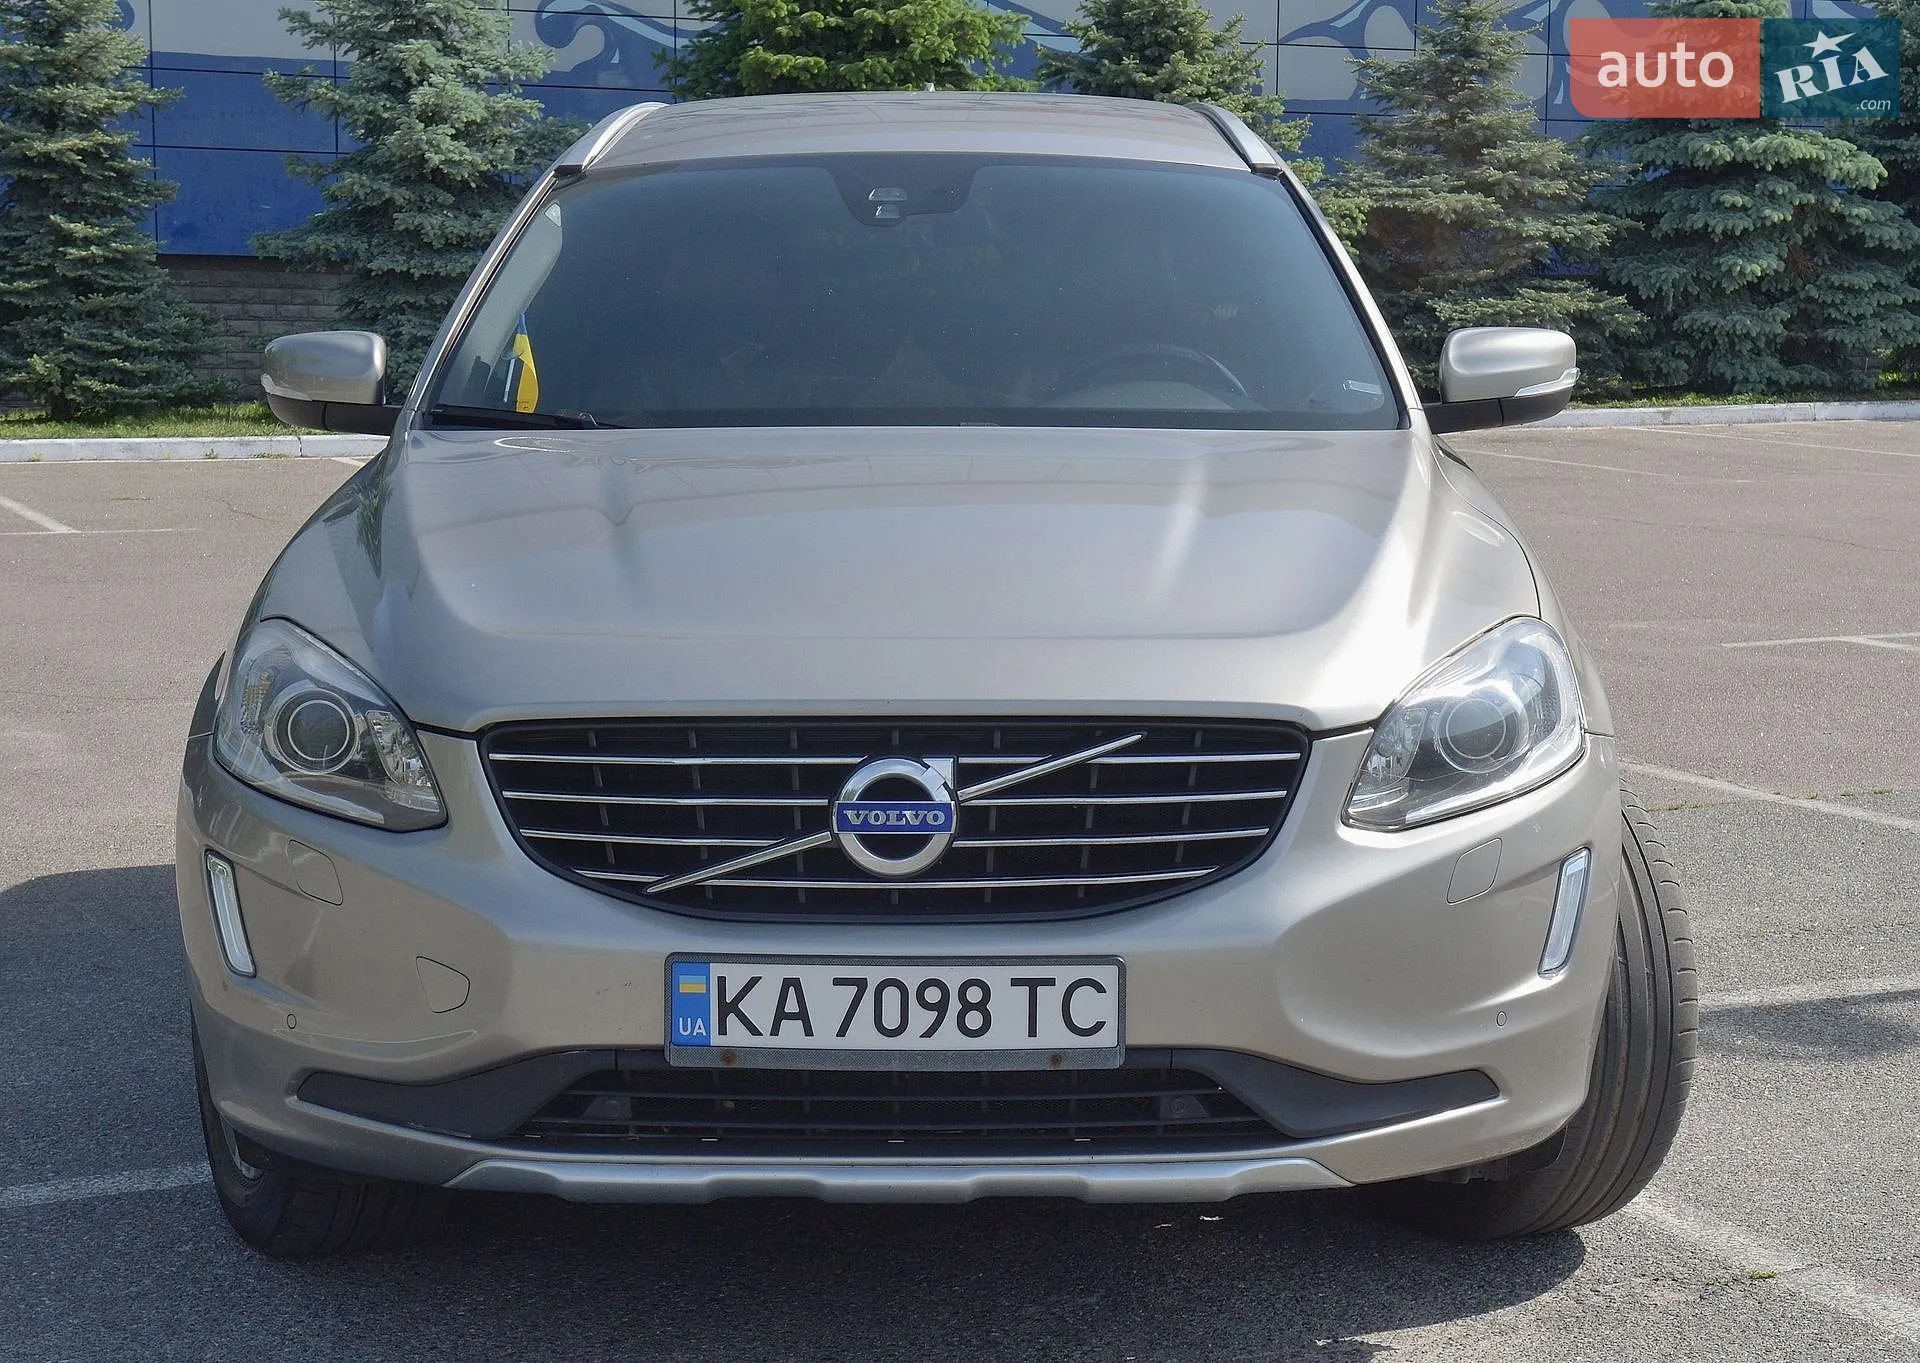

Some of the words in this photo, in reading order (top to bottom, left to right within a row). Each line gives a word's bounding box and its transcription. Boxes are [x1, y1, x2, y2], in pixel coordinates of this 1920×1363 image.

[843, 810, 945, 826] VOLVO
[716, 975, 814, 1037] KA
[832, 977, 992, 1039] 7098
[1010, 977, 1107, 1038] TC
[679, 1017, 707, 1037] UA
